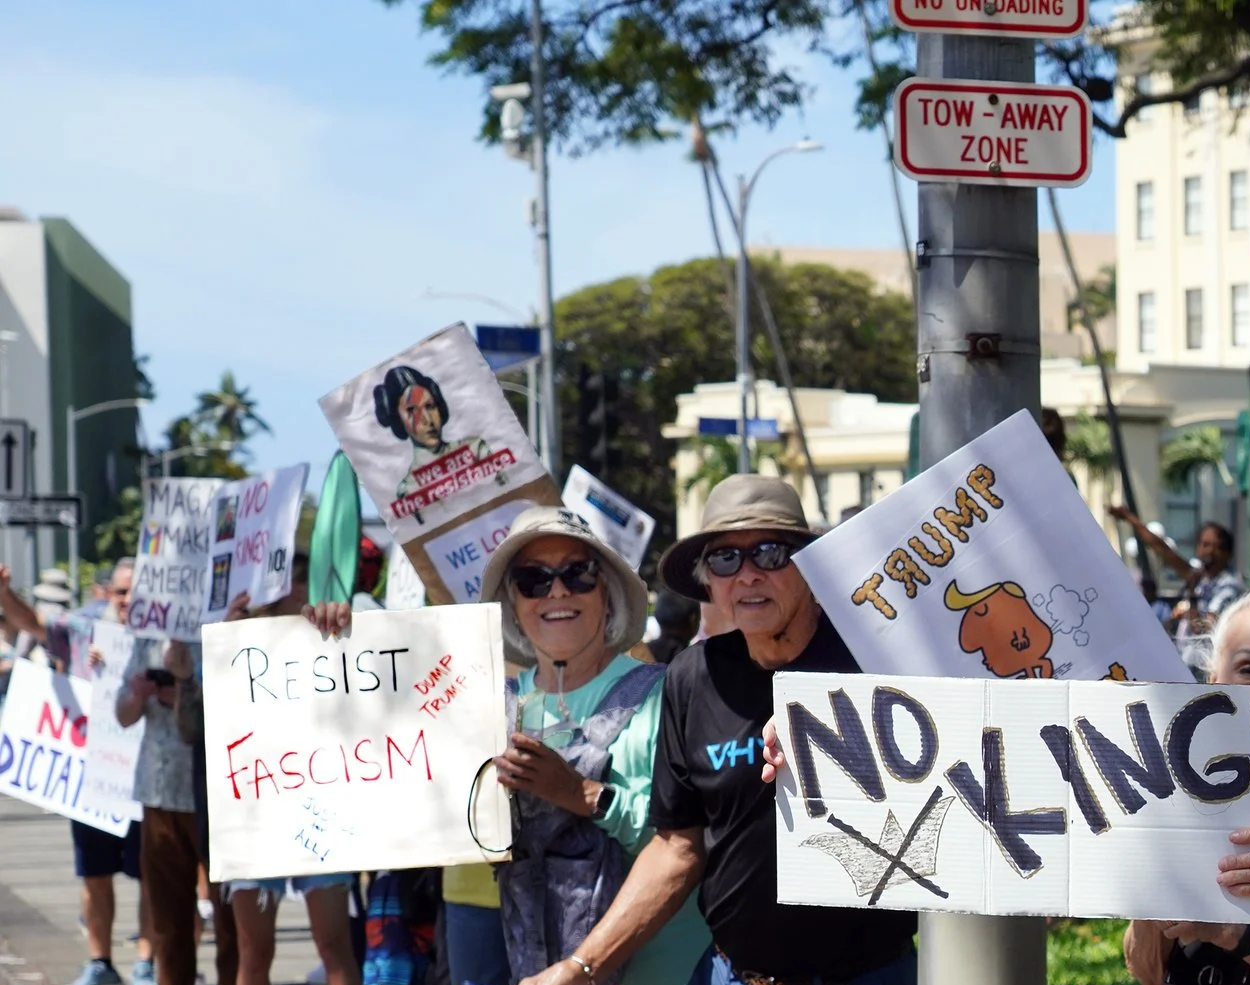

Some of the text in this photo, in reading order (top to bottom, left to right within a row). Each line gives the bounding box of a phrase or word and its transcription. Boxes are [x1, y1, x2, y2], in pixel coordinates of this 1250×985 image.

[956, 0, 1064, 15] UNOADING
[960, 136, 1029, 164] ZONE
[395, 452, 512, 517] the resistance
[417, 449, 475, 486] we are
[239, 480, 269, 519] NO
[446, 541, 481, 570] WE
[134, 563, 207, 595] AMERIC
[128, 597, 172, 631] GAY
[231, 647, 410, 703] RESIST
[413, 653, 453, 695] DUMP
[418, 675, 468, 720] TRUMP
[225, 729, 433, 800] FASCISM
[785, 685, 939, 818] NO
